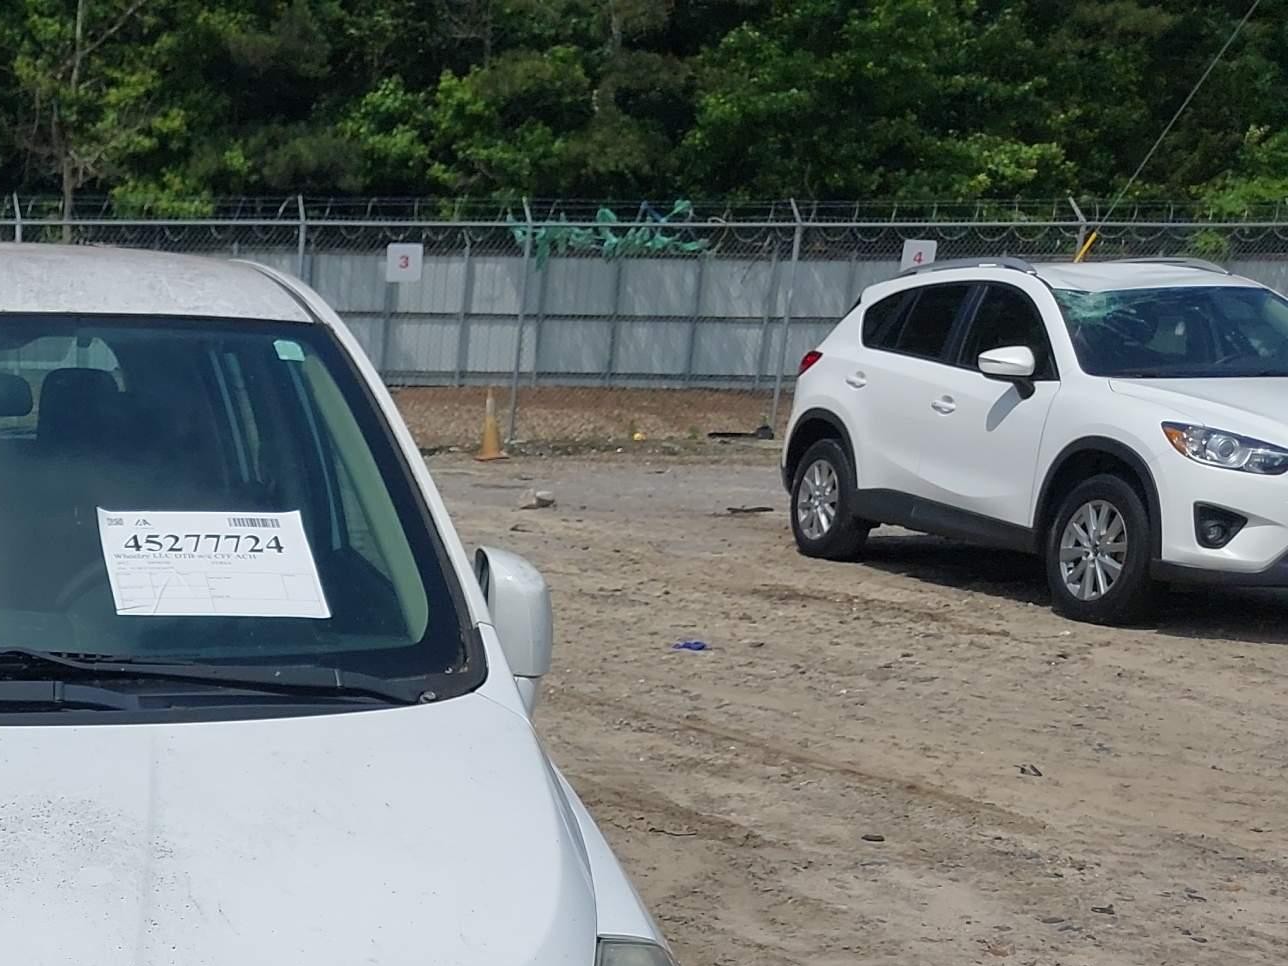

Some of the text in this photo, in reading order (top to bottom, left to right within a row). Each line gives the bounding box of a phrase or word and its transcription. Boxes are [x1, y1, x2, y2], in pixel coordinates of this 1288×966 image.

[399, 255, 409, 269] 3
[912, 251, 923, 264] 4
[124, 533, 285, 553] 45277724
